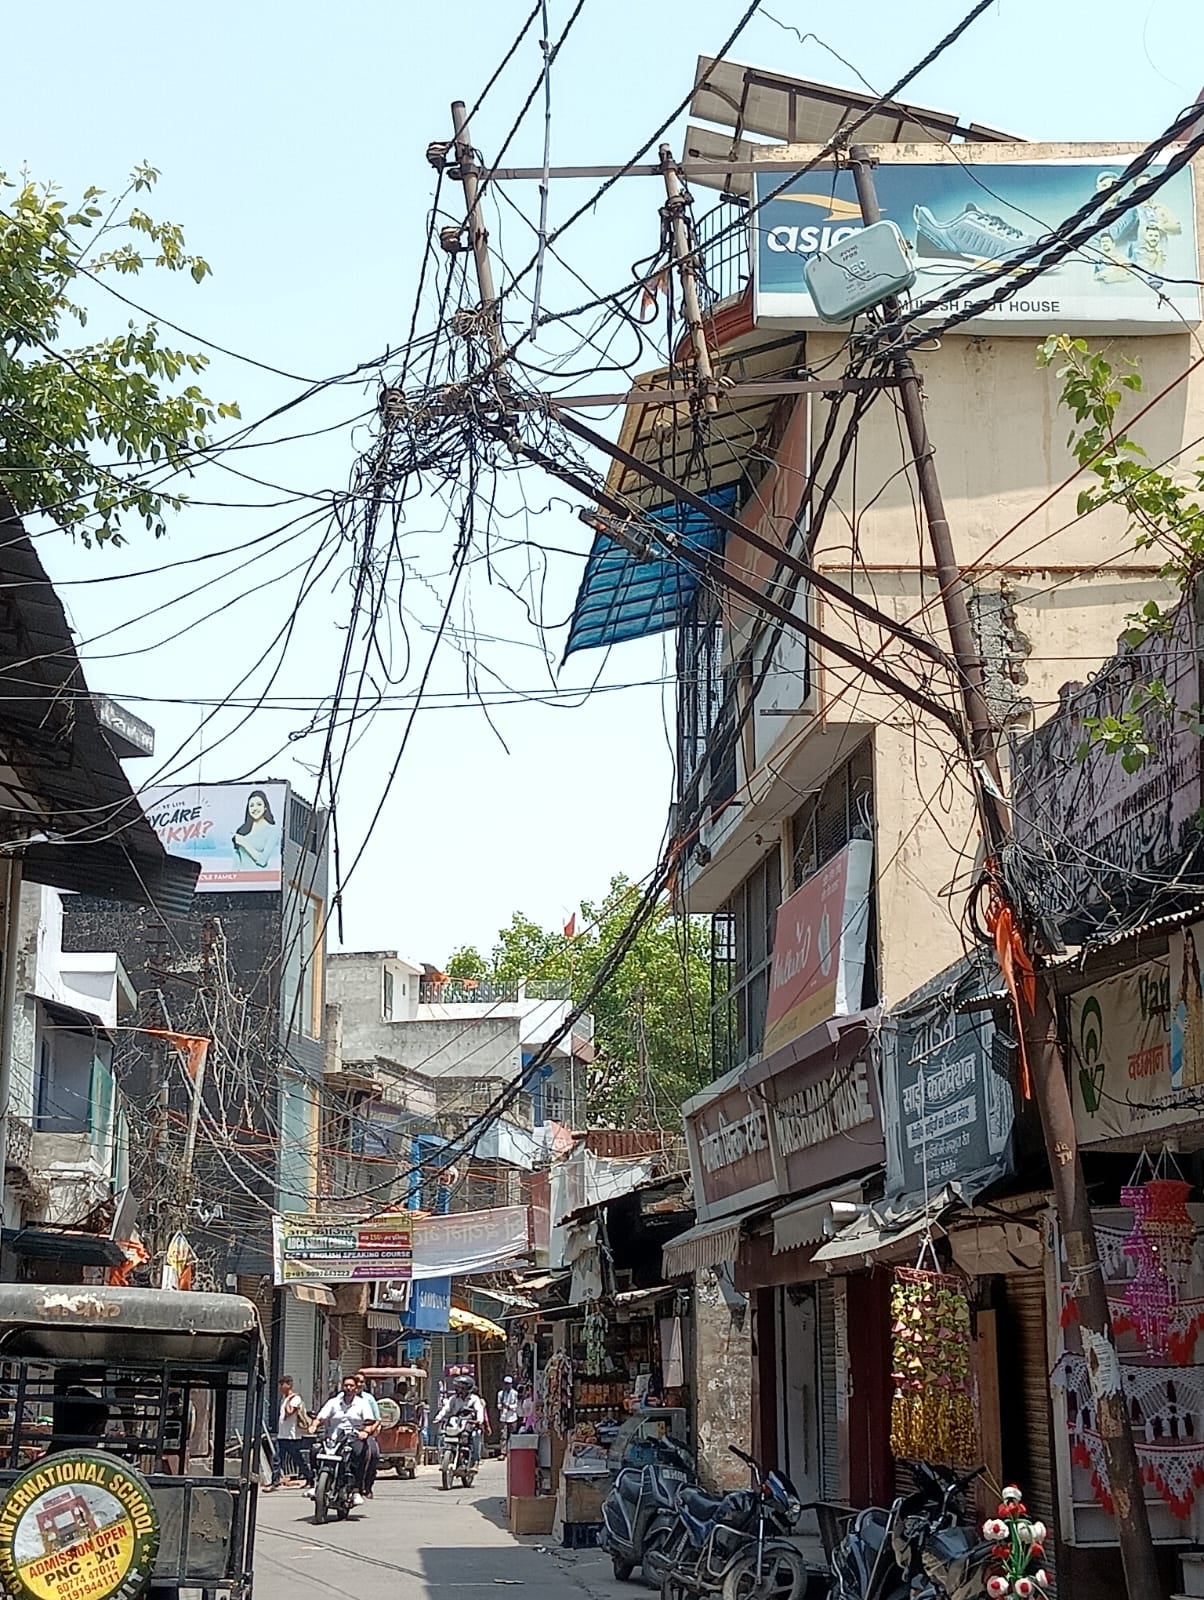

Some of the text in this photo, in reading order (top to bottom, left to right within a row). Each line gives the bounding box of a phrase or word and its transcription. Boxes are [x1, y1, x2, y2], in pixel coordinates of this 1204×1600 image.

[1009, 300, 1061, 313] HOUSE
[167, 820, 213, 844] KYA?
[342, 1251, 380, 1259] SPEAKING
[0, 1462, 107, 1544] INTERNATIONAL
[109, 1474, 154, 1540] SCHOOL
[28, 1524, 128, 1580] ADMISSION OPEN
[44, 1562, 82, 1587] PNC
[95, 1542, 121, 1565] XII
[56, 1559, 118, 1595] 80774 47012
